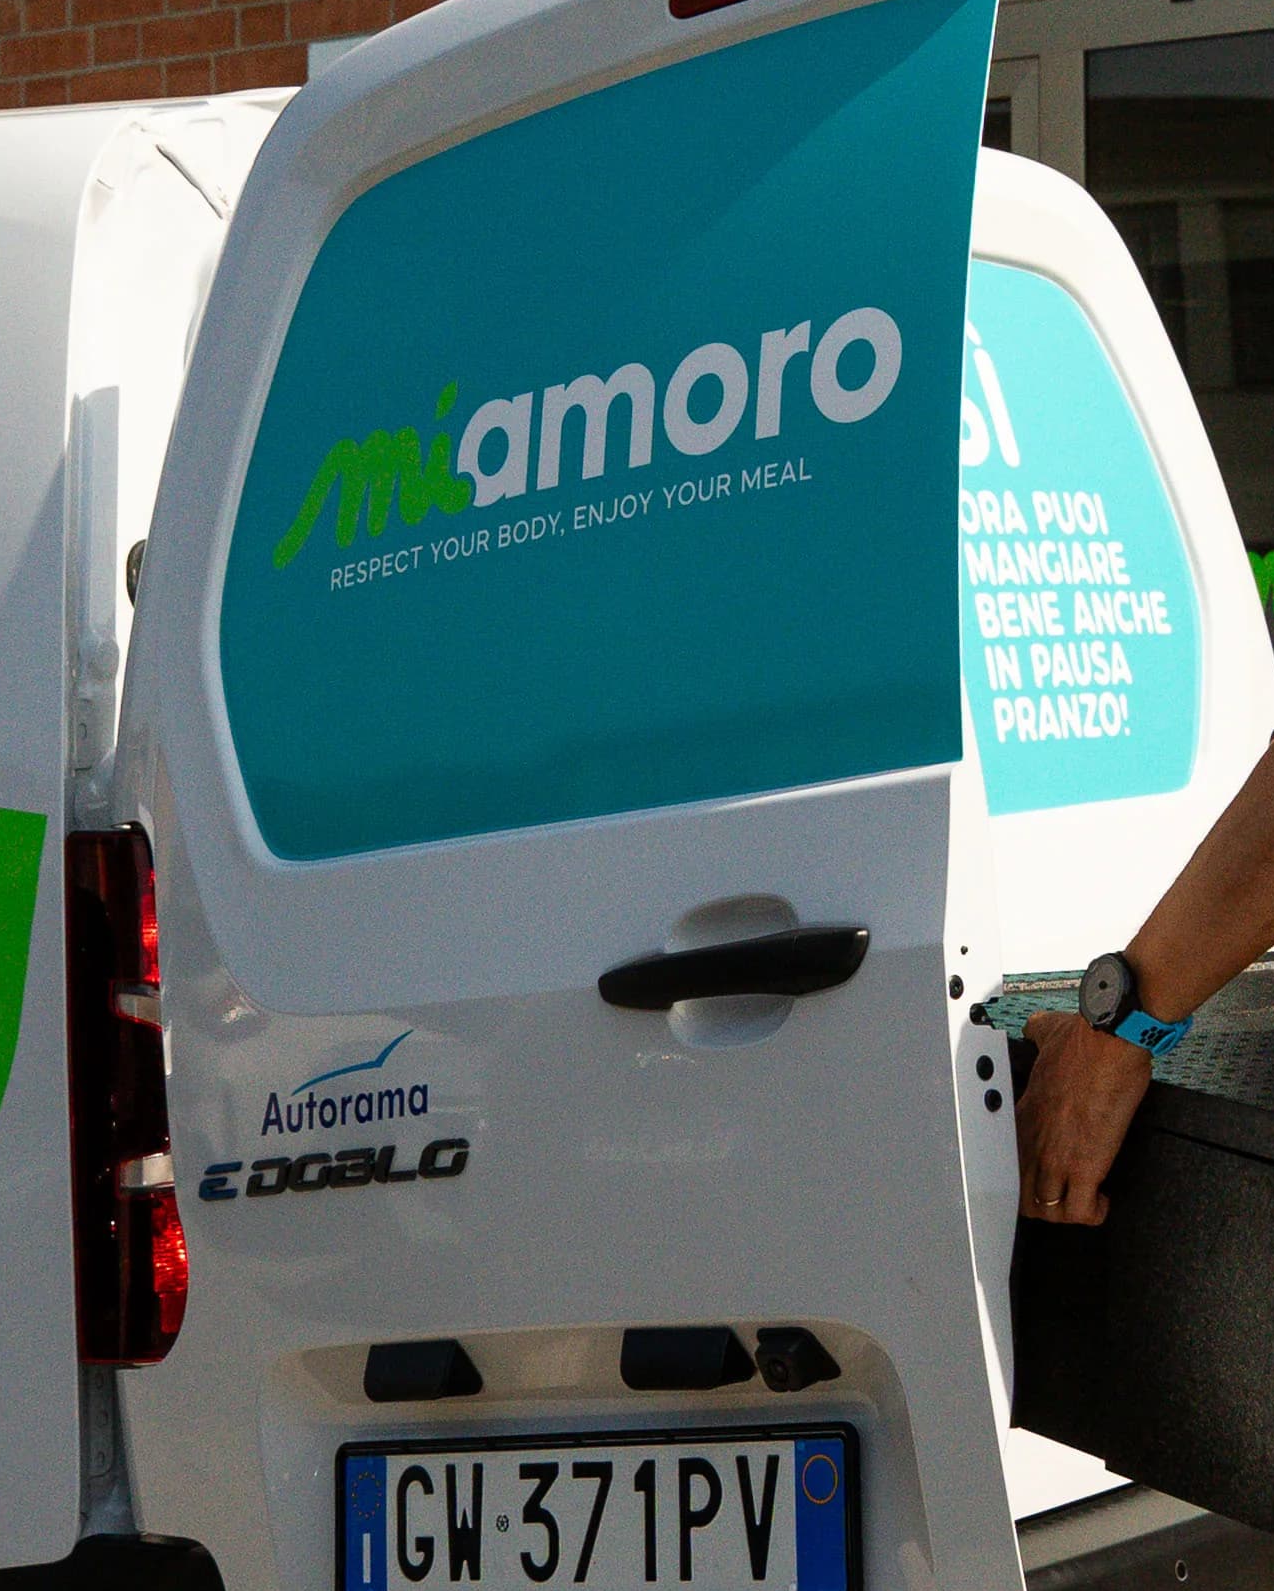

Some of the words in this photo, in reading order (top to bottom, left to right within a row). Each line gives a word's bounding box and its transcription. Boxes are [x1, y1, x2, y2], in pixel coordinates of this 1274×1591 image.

[273, 307, 902, 568] miamoro
[330, 546, 423, 591] RESPECT
[430, 529, 490, 564] YOUR
[498, 512, 565, 548] BODY,
[574, 490, 654, 530] ENJOY
[663, 474, 731, 509] YOUR
[741, 458, 812, 493] MEAL
[1032, 491, 1108, 535] PUOI
[965, 542, 1130, 586] MANGIARE
[975, 592, 1064, 638] BENE
[1074, 591, 1172, 635] ANCHE
[985, 645, 1022, 690] IN
[1031, 641, 1132, 688] PAUSA
[993, 693, 1130, 743] PRANZO!
[261, 1084, 428, 1136] Autorama
